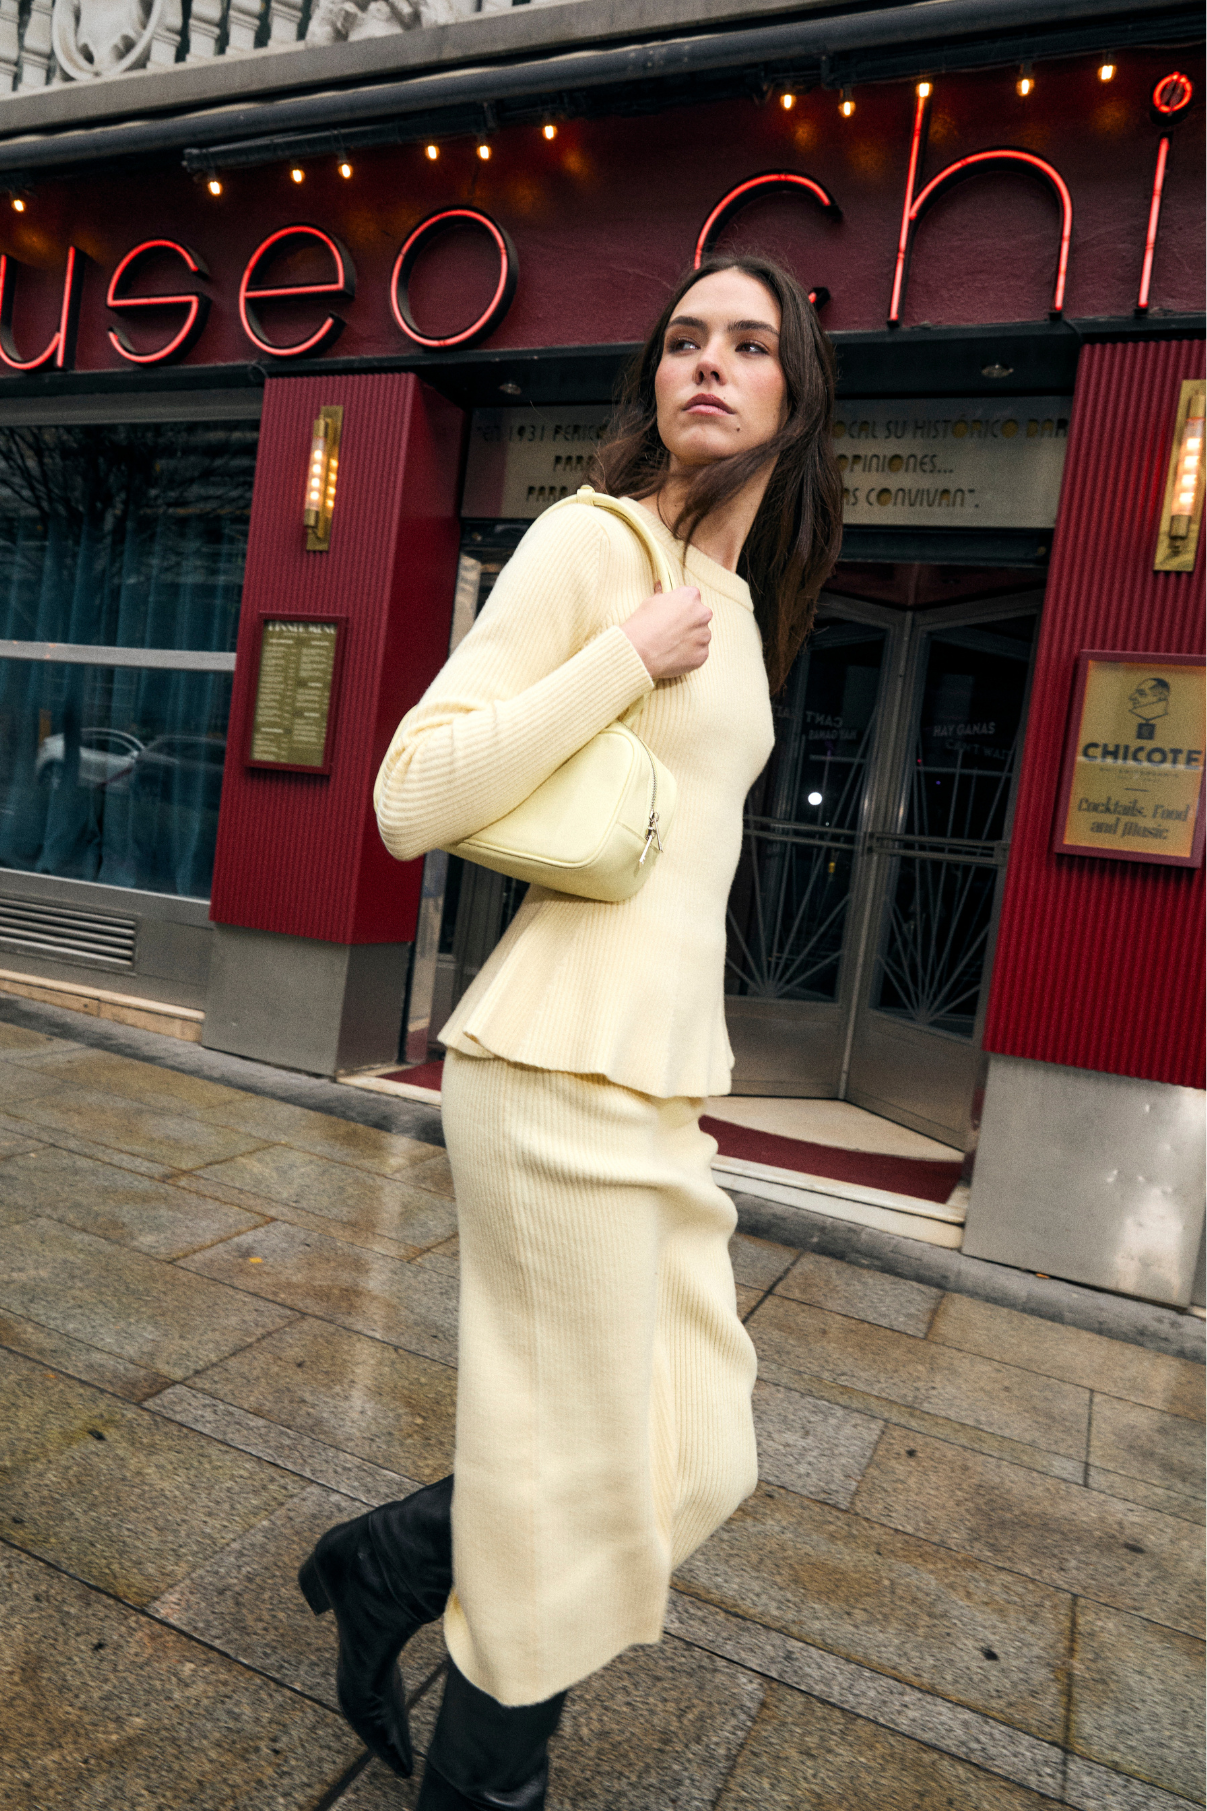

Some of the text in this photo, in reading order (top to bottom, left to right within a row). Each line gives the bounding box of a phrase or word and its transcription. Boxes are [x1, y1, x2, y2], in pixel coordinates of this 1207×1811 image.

[508, 424, 545, 442] 1931
[833, 418, 877, 438] OCAL
[885, 418, 906, 438] SU
[913, 413, 1019, 438] HISTÓRICO
[1026, 418, 1069, 438] BAR
[932, 721, 996, 736] HAY GANAS
[1081, 742, 1203, 770] CHICOTE
[1152, 803, 1190, 822] Food
[1090, 817, 1170, 840] and Music
